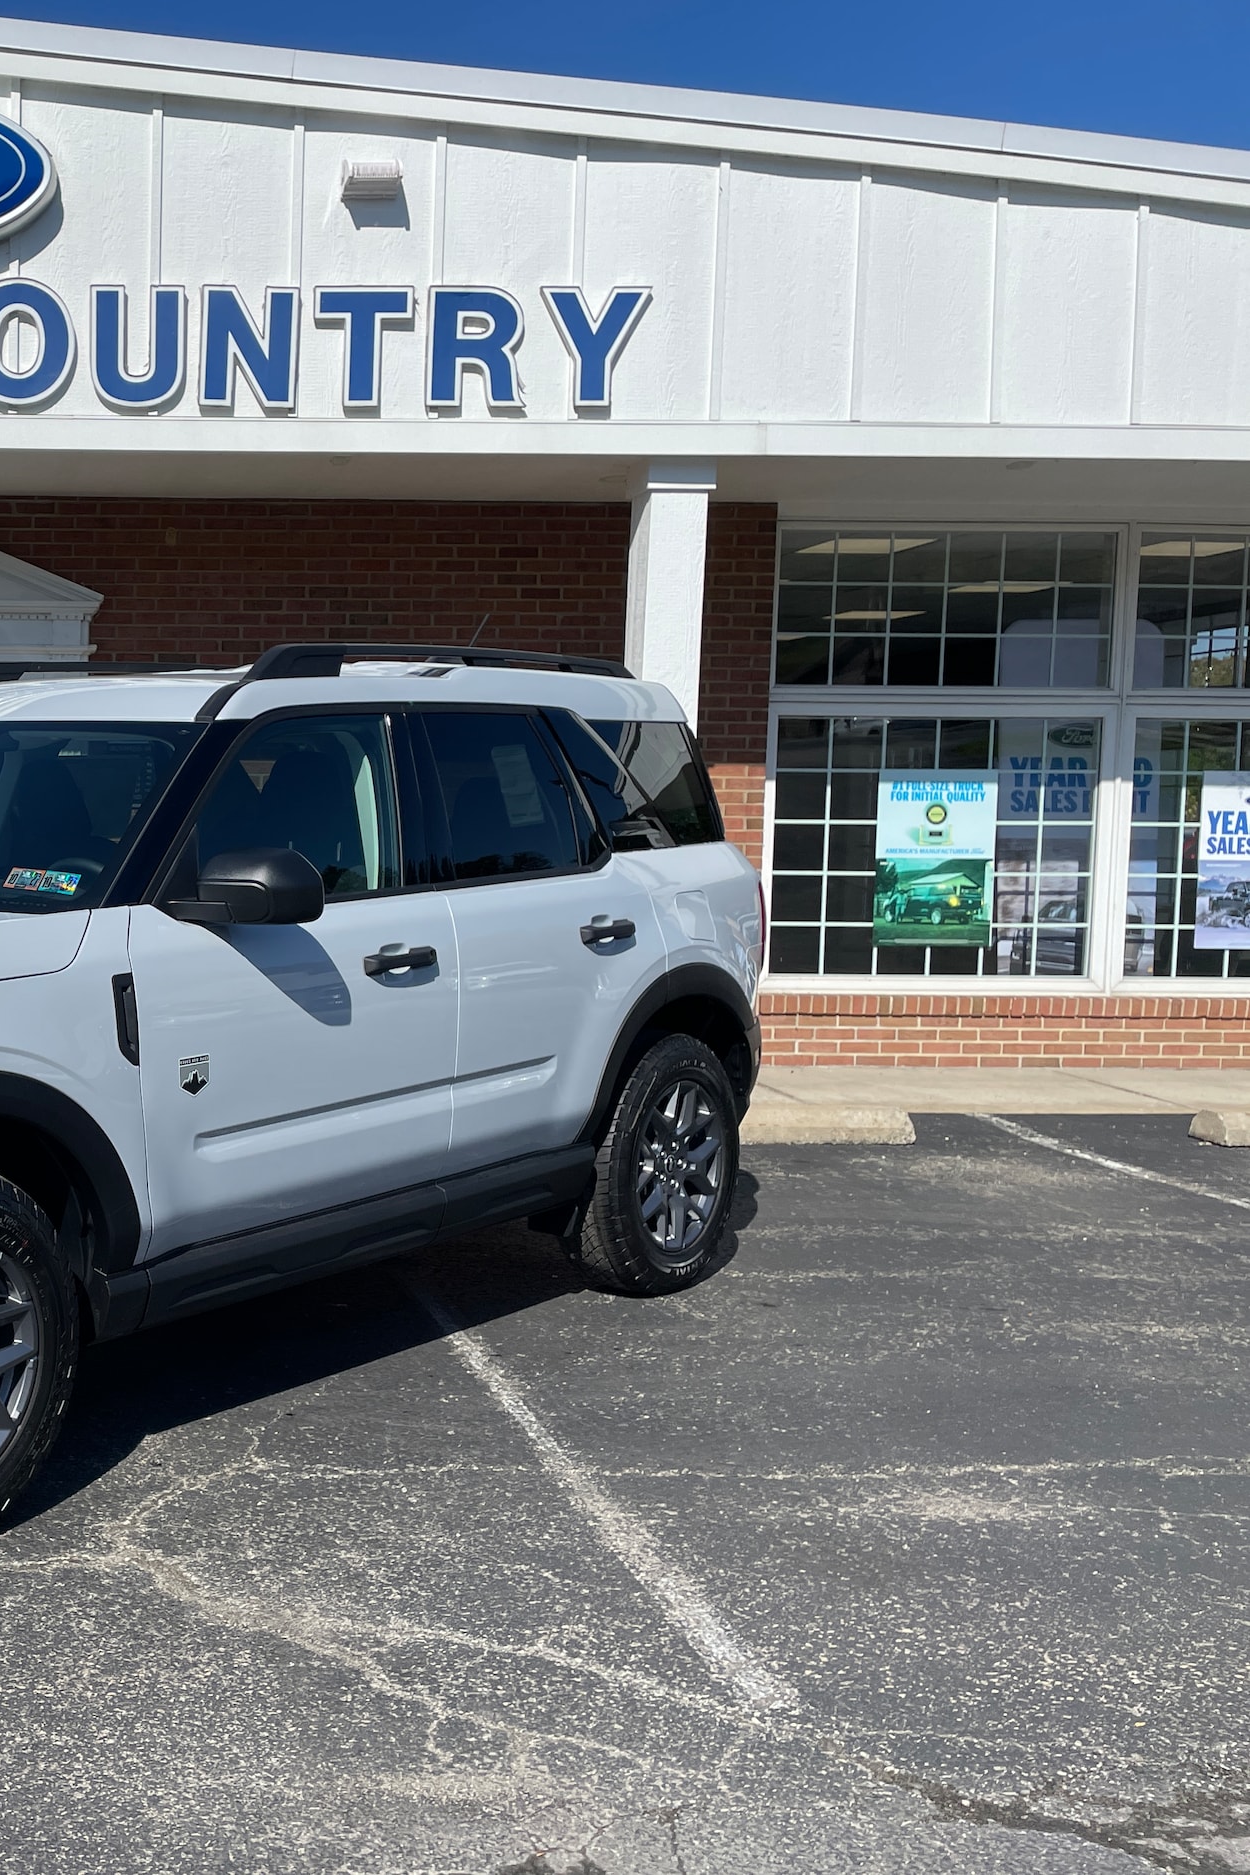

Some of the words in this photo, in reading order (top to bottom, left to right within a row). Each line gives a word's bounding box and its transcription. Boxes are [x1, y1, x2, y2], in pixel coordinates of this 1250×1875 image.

[1009, 756, 1088, 788] YEAR
[906, 780, 949, 791] FULL-SIZE
[953, 780, 984, 791] TRUCK
[890, 791, 909, 801] FOR
[911, 791, 943, 801] INITIAL
[947, 791, 986, 803] QUALITY
[1207, 810, 1250, 835] YEA
